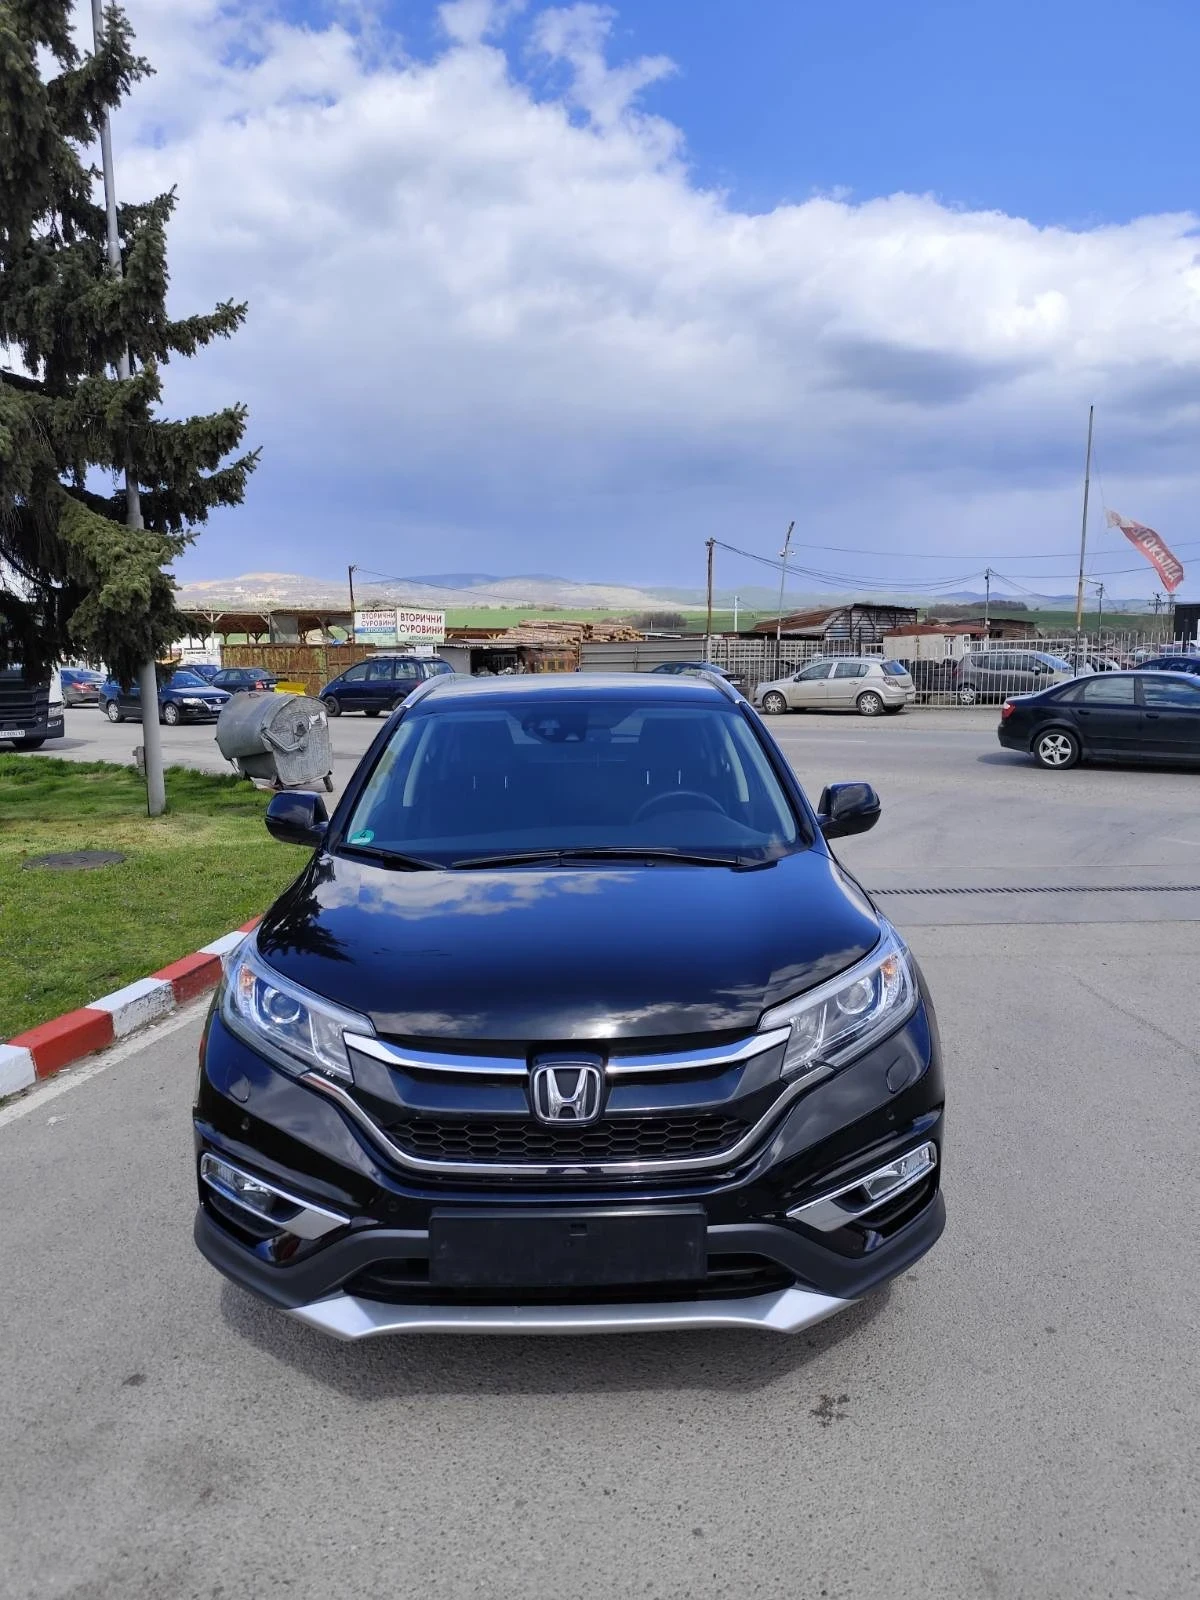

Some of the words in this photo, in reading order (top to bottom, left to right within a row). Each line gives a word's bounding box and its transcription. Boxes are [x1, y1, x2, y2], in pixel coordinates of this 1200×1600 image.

[361, 612, 396, 620] ВТОРИЧНИ
[400, 612, 442, 624] ВТОРИЧНИ
[361, 619, 396, 627] СУРОВИНИ
[399, 624, 443, 634] СУРОВИНИ
